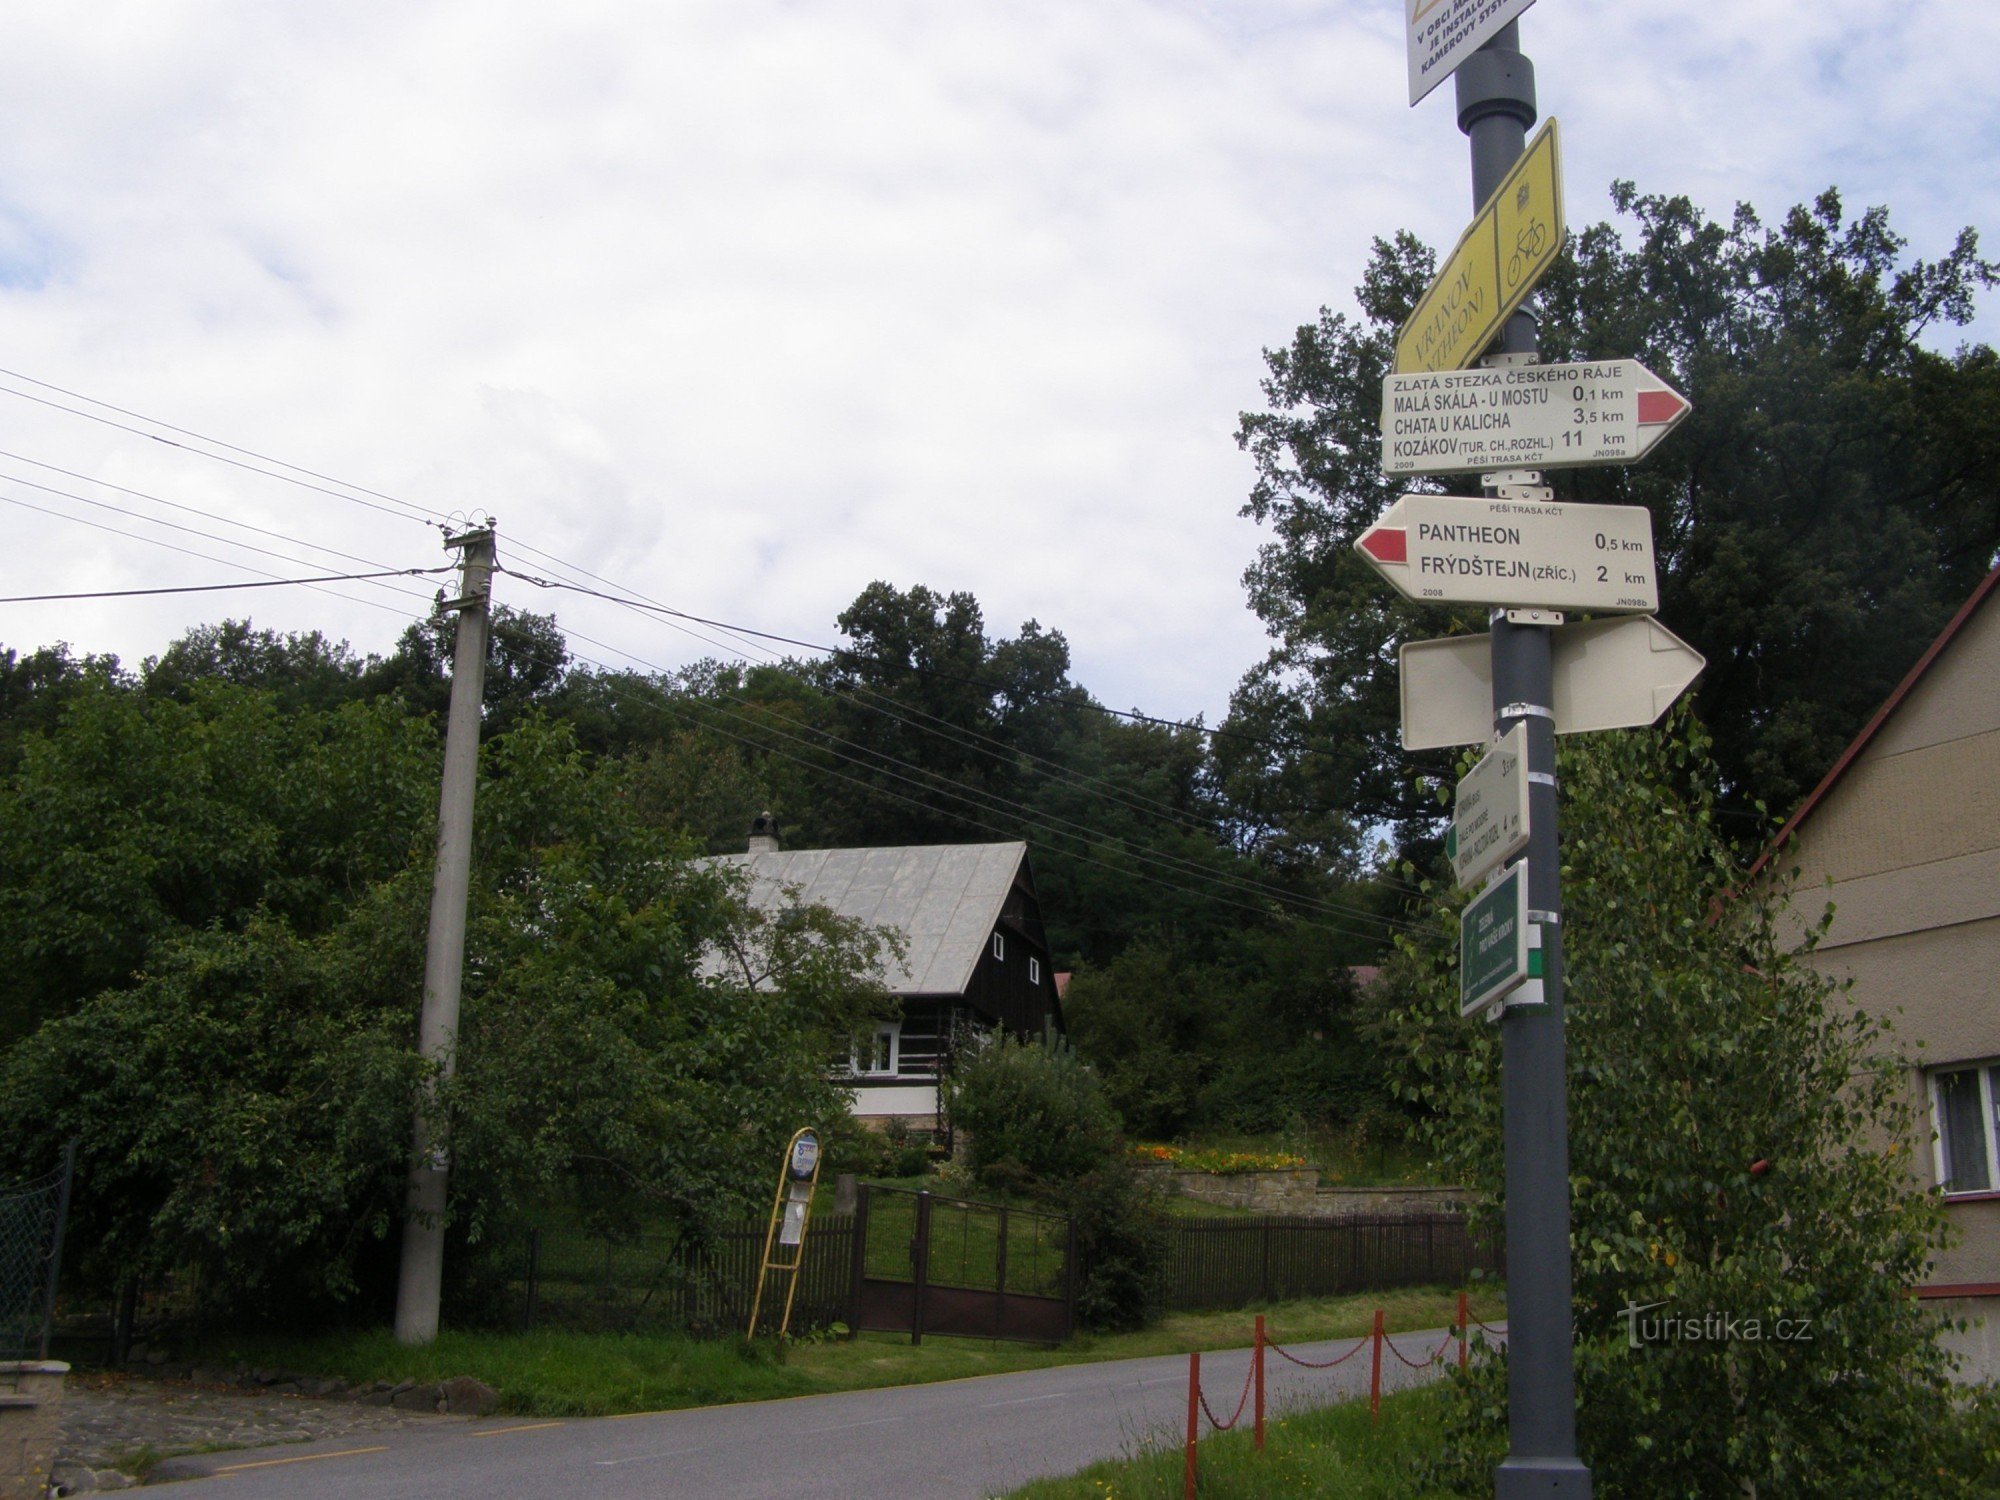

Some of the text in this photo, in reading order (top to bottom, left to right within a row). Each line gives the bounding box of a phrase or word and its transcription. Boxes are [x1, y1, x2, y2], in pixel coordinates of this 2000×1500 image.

[1479, 0, 1508, 24] SYST
[1417, 32, 1424, 44] V
[1427, 9, 1450, 37] OBCI
[1429, 0, 1489, 52] JE INSTALO
[1415, 261, 1473, 363] VRANOV
[1394, 365, 1623, 392] ZLATÁ STEZKA ČESKÉHO RÁJE
[1394, 391, 1431, 413] MALÁ
[1434, 389, 1478, 411] SKÁLA
[1489, 391, 1498, 407] U
[1502, 388, 1549, 406] MOSTU
[1573, 385, 1596, 402] 0,1
[1602, 389, 1624, 400] km
[1394, 407, 1624, 435] CHATA U KALICHA 3,5 km
[1394, 436, 1459, 457] KOZÁKOV
[1459, 441, 1486, 456] (TUR.
[1561, 430, 1583, 447] 11
[1603, 433, 1625, 444] km
[1394, 461, 1415, 469] 2009
[1491, 453, 1522, 464] TRASA
[1513, 506, 1543, 515] TRASA
[1419, 523, 1643, 552] PANTHEON 0,5 km
[1421, 554, 1646, 584] FRÝDŠTEJN (ZŘÍC.) 2 km
[1422, 588, 1443, 597] 2008
[1616, 598, 1647, 607] JN098b
